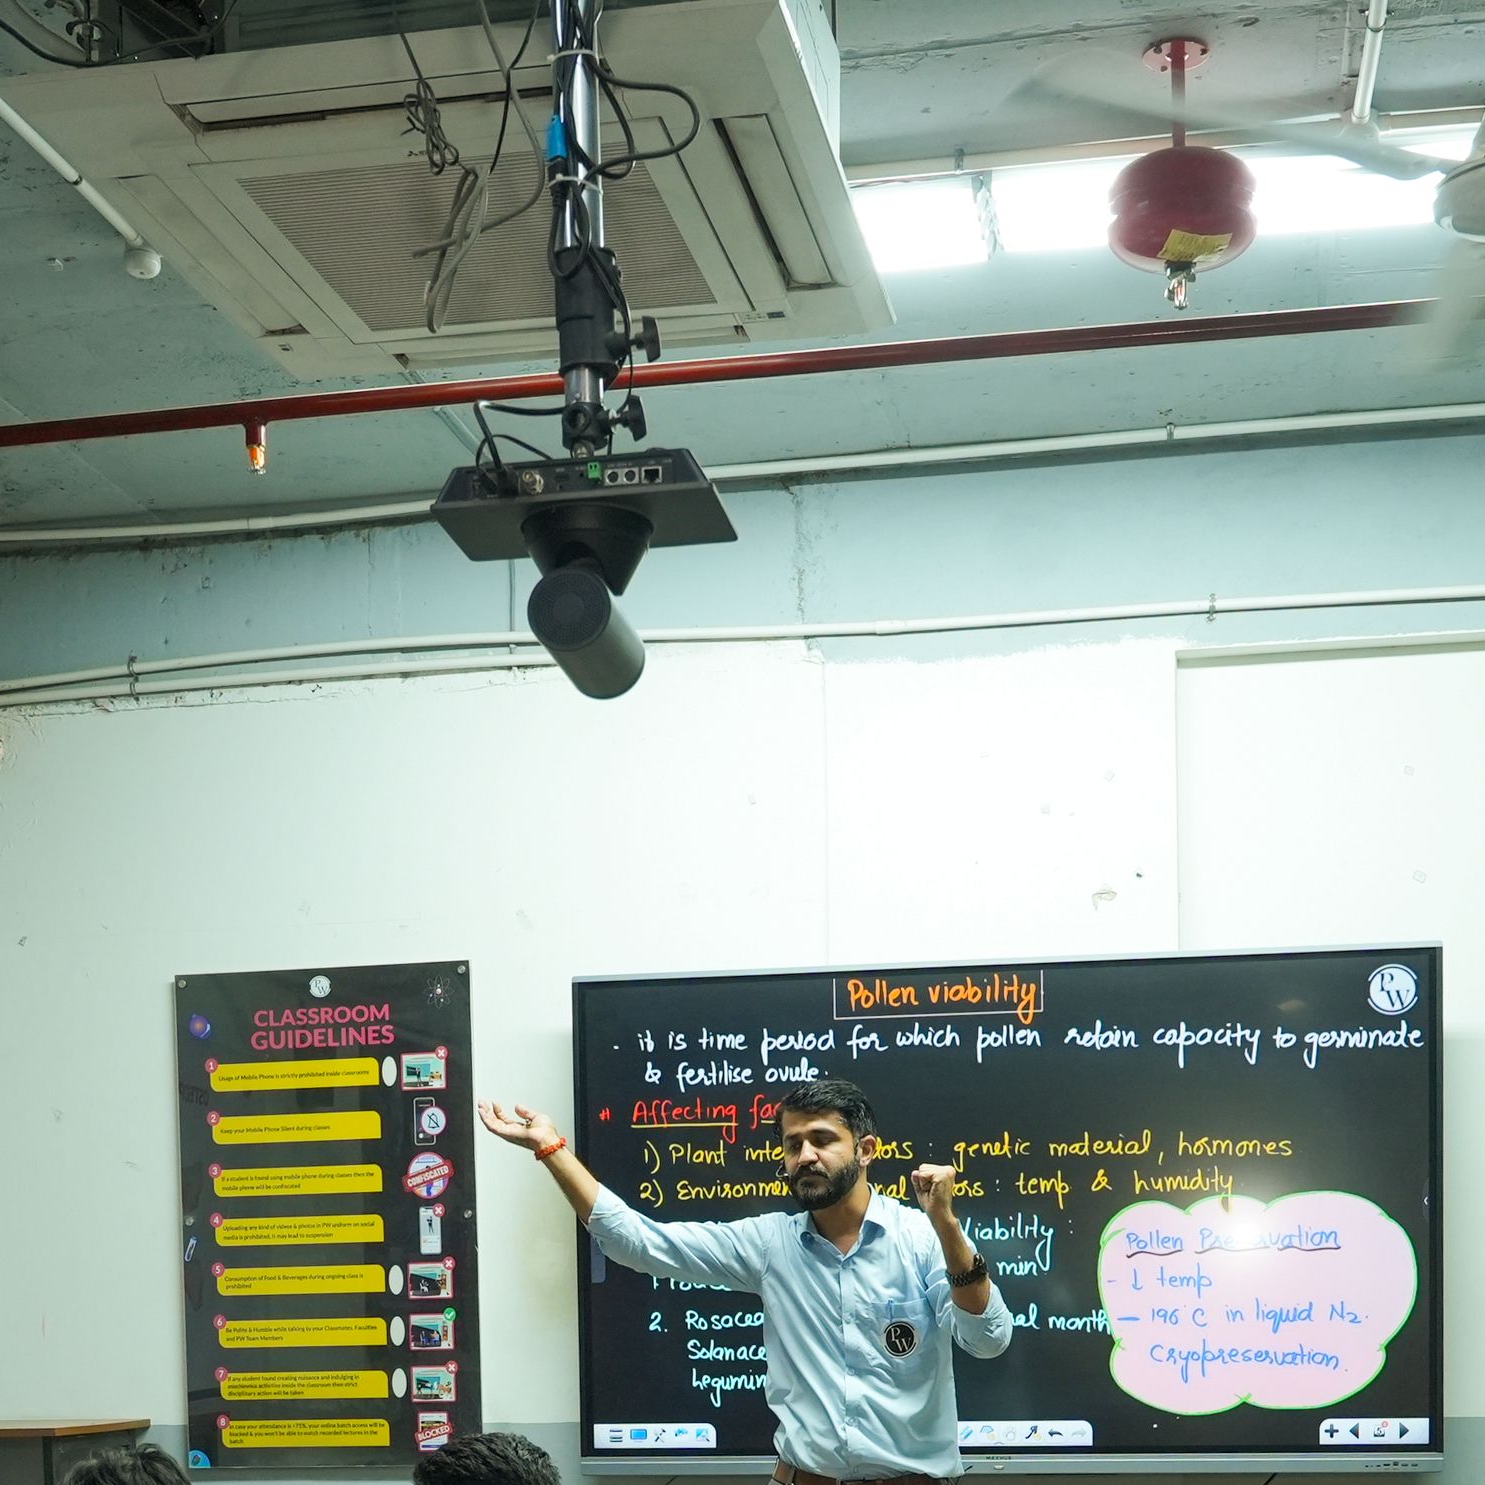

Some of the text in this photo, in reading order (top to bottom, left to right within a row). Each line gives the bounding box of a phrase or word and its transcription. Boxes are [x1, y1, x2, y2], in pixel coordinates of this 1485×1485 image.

[254, 1003, 390, 1027] CLASSROOM
[848, 974, 1036, 1024] Pollen viability
[251, 1024, 395, 1050] GUIDELINES
[638, 1030, 655, 1052] it
[668, 1030, 687, 1051] is
[699, 1027, 748, 1051] time
[762, 1027, 835, 1066] period
[847, 1024, 889, 1059] for
[895, 1021, 960, 1048] which
[977, 1024, 1041, 1063] pollen
[1153, 1022, 1260, 1068] capacity
[1273, 1025, 1296, 1049] to
[1304, 1020, 1424, 1069] germinate
[676, 1057, 754, 1093] fertilise
[633, 1097, 737, 1144] Affecting
[669, 1139, 727, 1167] Plant
[953, 1131, 1030, 1172] genetic
[1178, 1131, 1293, 1157] hormones
[1134, 1165, 1234, 1212] humidity
[1126, 1229, 1183, 1251] Pollen
[1157, 1262, 1212, 1298] temp
[1226, 1305, 1244, 1323] in
[1255, 1297, 1314, 1334] liquid
[888, 1325, 913, 1354] PW
[417, 1425, 450, 1441] BLOCKED
